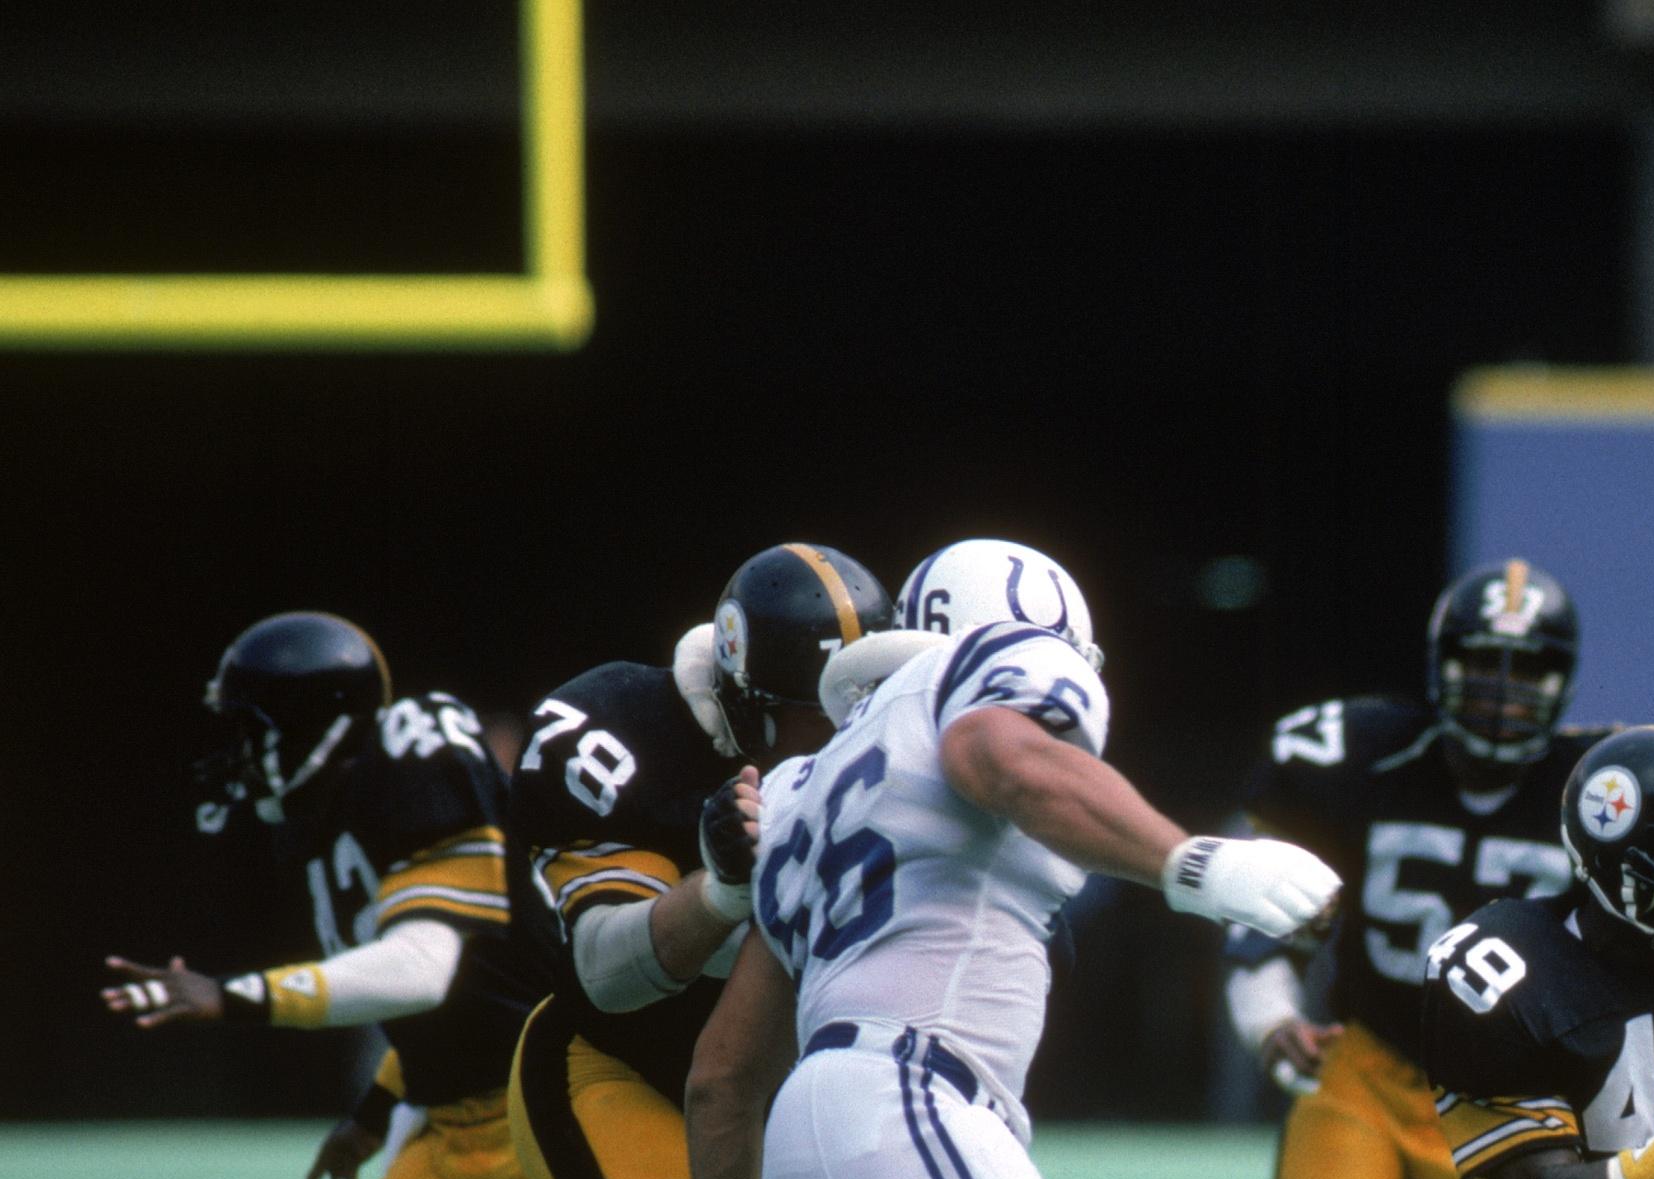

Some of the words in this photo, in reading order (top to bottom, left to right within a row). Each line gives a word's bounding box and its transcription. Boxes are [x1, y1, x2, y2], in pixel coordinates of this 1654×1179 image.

[894, 588, 951, 637] 6
[520, 698, 637, 817] 78
[758, 745, 893, 990] 66
[1426, 922, 1527, 1015] 49
